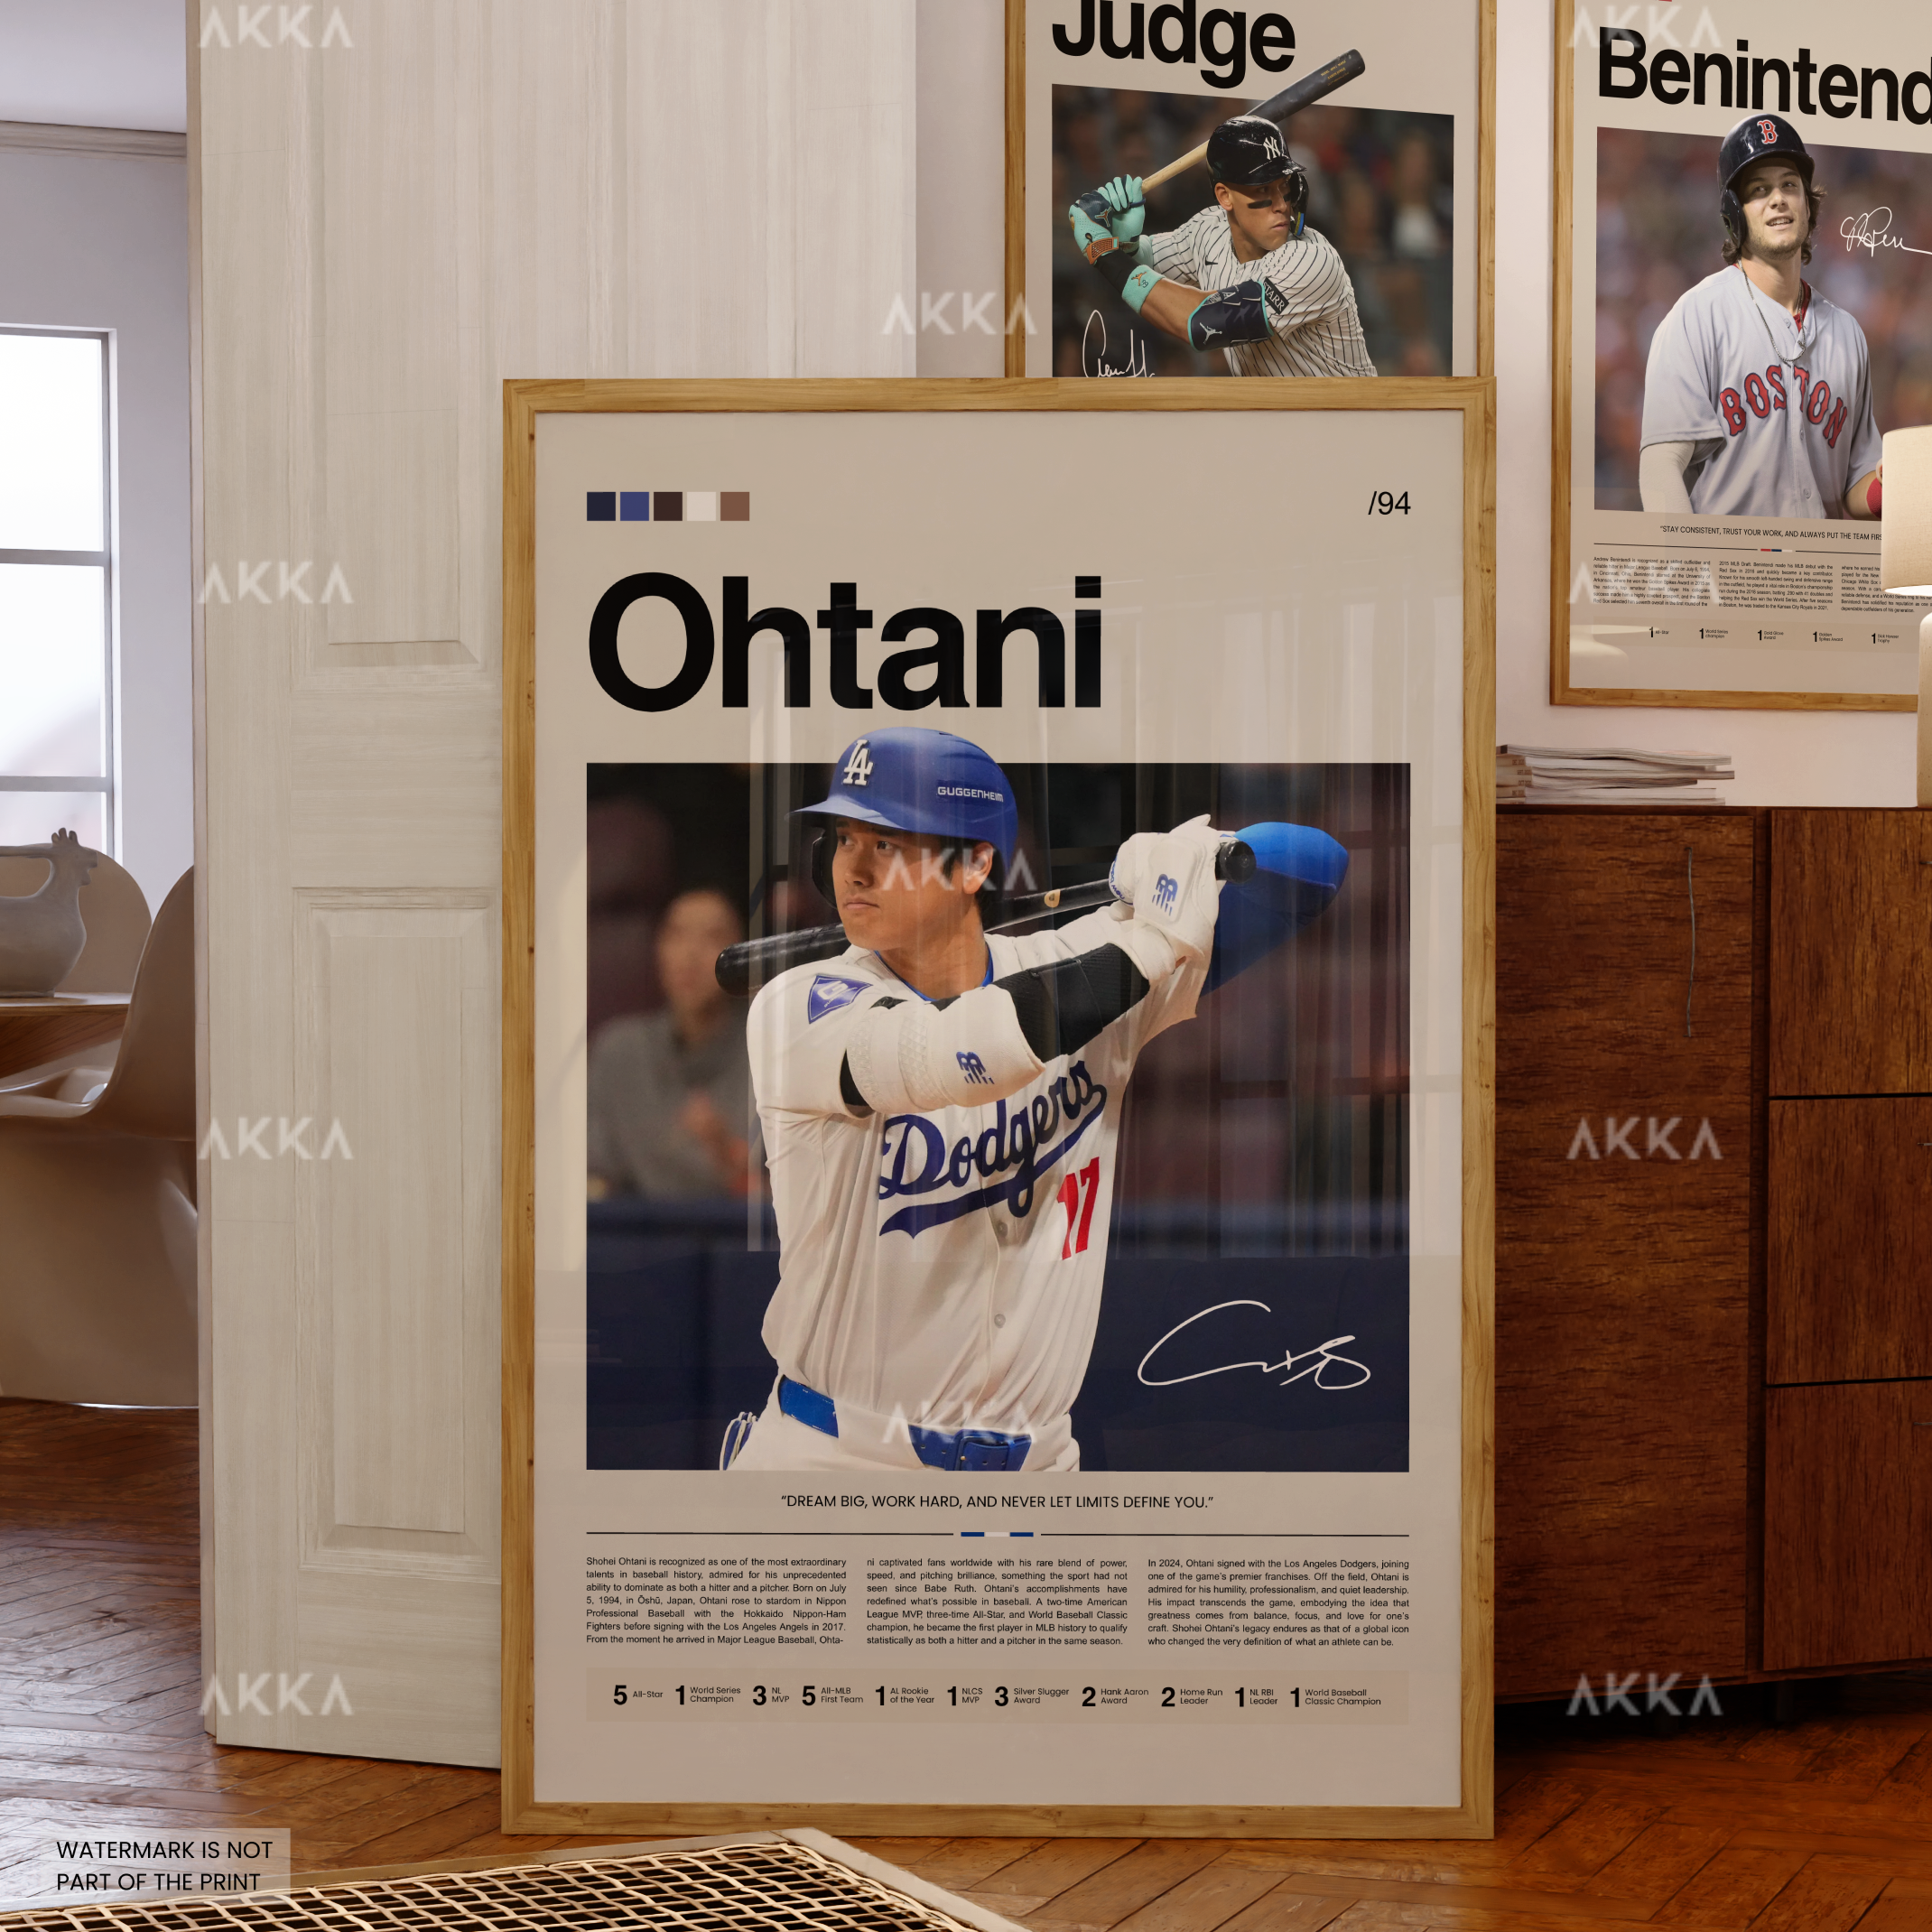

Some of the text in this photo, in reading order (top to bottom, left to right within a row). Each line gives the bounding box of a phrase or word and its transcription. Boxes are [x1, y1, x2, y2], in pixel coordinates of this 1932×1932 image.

[1052, 0, 1296, 88] Judge
[1263, 281, 1285, 311] STARR
[1719, 364, 1848, 449] BOSTON
[1368, 490, 1411, 516] /94
[1699, 627, 1704, 639] 1
[1757, 629, 1762, 640] 1
[1813, 631, 1817, 642] 1
[1871, 633, 1876, 644] 1
[590, 574, 1101, 711] Ohtani
[843, 738, 874, 786] LA
[937, 785, 1004, 803] GUGGENHEIM
[878, 1060, 1108, 1219] Dodgers
[1056, 1156, 1101, 1261] 17
[841, 1495, 868, 1509] BIG,
[871, 1495, 915, 1507] WORK
[920, 1495, 962, 1509] HARD,
[967, 1495, 998, 1508] AND
[1002, 1496, 1045, 1507] NEVER
[1051, 1496, 1073, 1508] LET
[1076, 1496, 1119, 1508] LIMITS
[1124, 1496, 1170, 1508] DEFINE
[586, 1556, 616, 1565] Shohei
[618, 1556, 646, 1565] Ohtani
[649, 1557, 656, 1565] is
[659, 1557, 705, 1567] recognized
[739, 1557, 748, 1565] of
[751, 1557, 766, 1565] the
[767, 1557, 788, 1566] most
[791, 1557, 847, 1568] extraordinary
[867, 1557, 875, 1565] ni
[879, 1558, 923, 1567] captivated
[927, 1557, 946, 1566] fans
[950, 1558, 993, 1566] worldwide
[997, 1558, 1015, 1566] with
[1019, 1558, 1032, 1566] his
[1058, 1558, 1082, 1567] blend
[1086, 1558, 1095, 1567] of
[1101, 1560, 1128, 1568] power,
[1148, 1558, 1409, 1570] In 2024, Ohtani signed with the Los Angeles Dodgers, joining
[614, 1685, 664, 1705] 5 All-Star
[675, 1685, 684, 1705] 1
[690, 1695, 734, 1704] Champion
[753, 1685, 767, 1705] 3
[772, 1686, 782, 1695] NL
[802, 1686, 816, 1706] 5
[821, 1686, 851, 1695] All-MLB
[875, 1686, 885, 1705] 1
[902, 1686, 929, 1695] Rookie
[947, 1686, 957, 1706] 1
[961, 1695, 980, 1704] MVP
[995, 1686, 1009, 1706] 3
[1014, 1687, 1070, 1696] Silver Slugger
[1014, 1695, 1041, 1704] Award
[1082, 1686, 1096, 1706] 2
[1161, 1686, 1175, 1707] 2
[1235, 1686, 1244, 1707] 1
[1290, 1687, 1299, 1707] 1
[1332, 1688, 1367, 1696] Baseball
[1101, 1696, 1128, 1704] Award
[1180, 1696, 1209, 1704] Leader
[1305, 1697, 1381, 1706] Classic Champion
